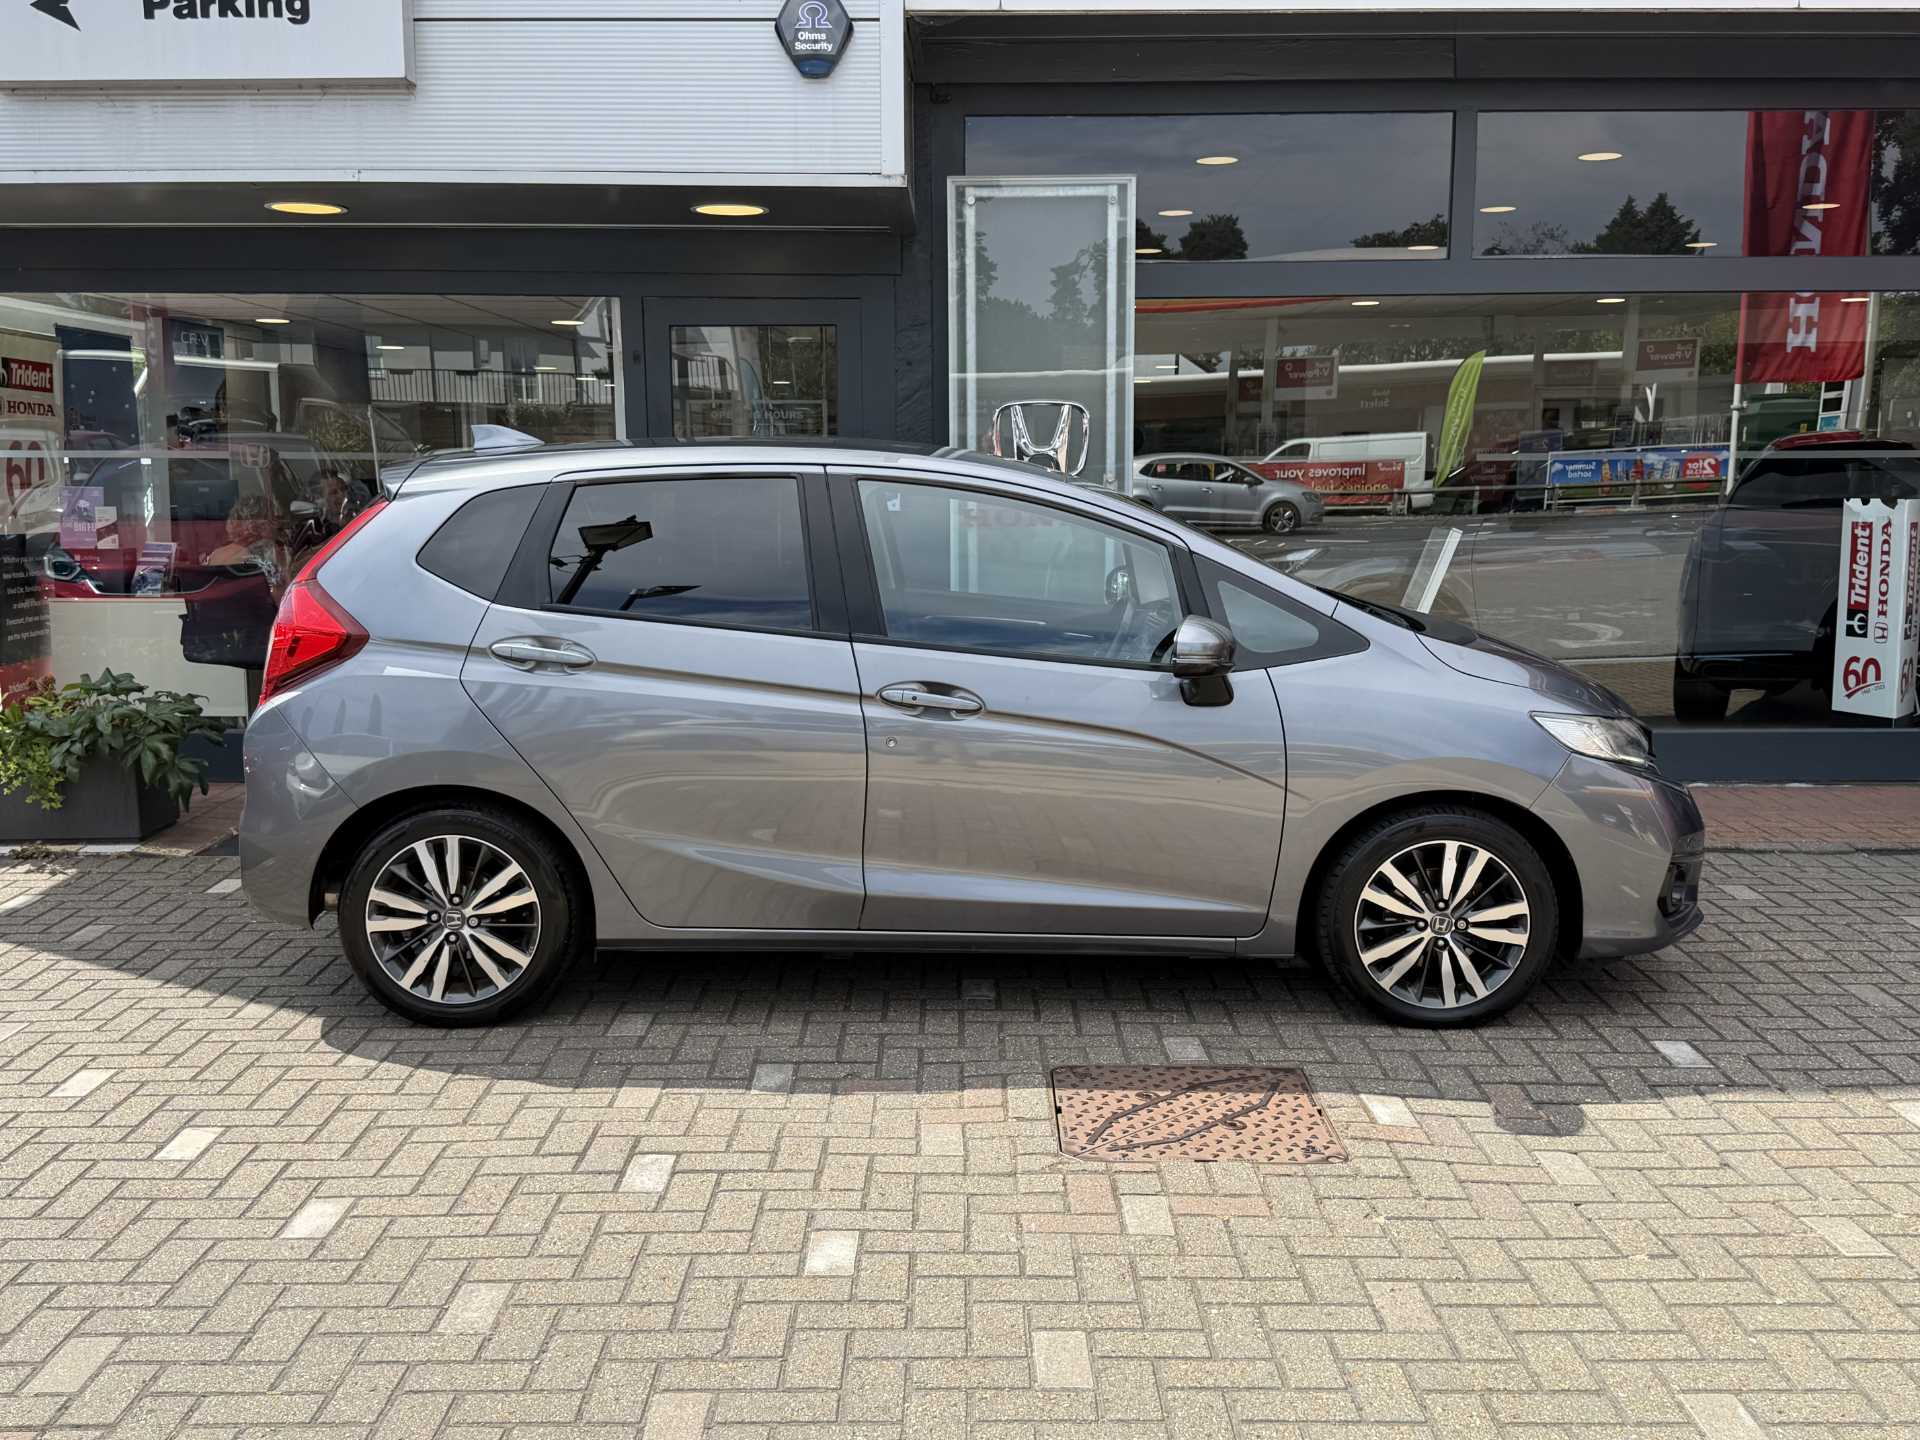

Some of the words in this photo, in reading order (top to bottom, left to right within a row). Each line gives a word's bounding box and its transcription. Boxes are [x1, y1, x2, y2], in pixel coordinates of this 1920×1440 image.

[142, 0, 311, 25] Parking
[794, 41, 833, 52] Security
[797, 31, 827, 41] Ohms
[180, 331, 209, 346] CR-V
[10, 362, 51, 389] Trident
[7, 399, 56, 417] HONDA
[764, 409, 804, 420] HOURS
[1851, 521, 1871, 606] Trident
[1877, 518, 1892, 618] HONDA
[1842, 655, 1882, 693] 60
